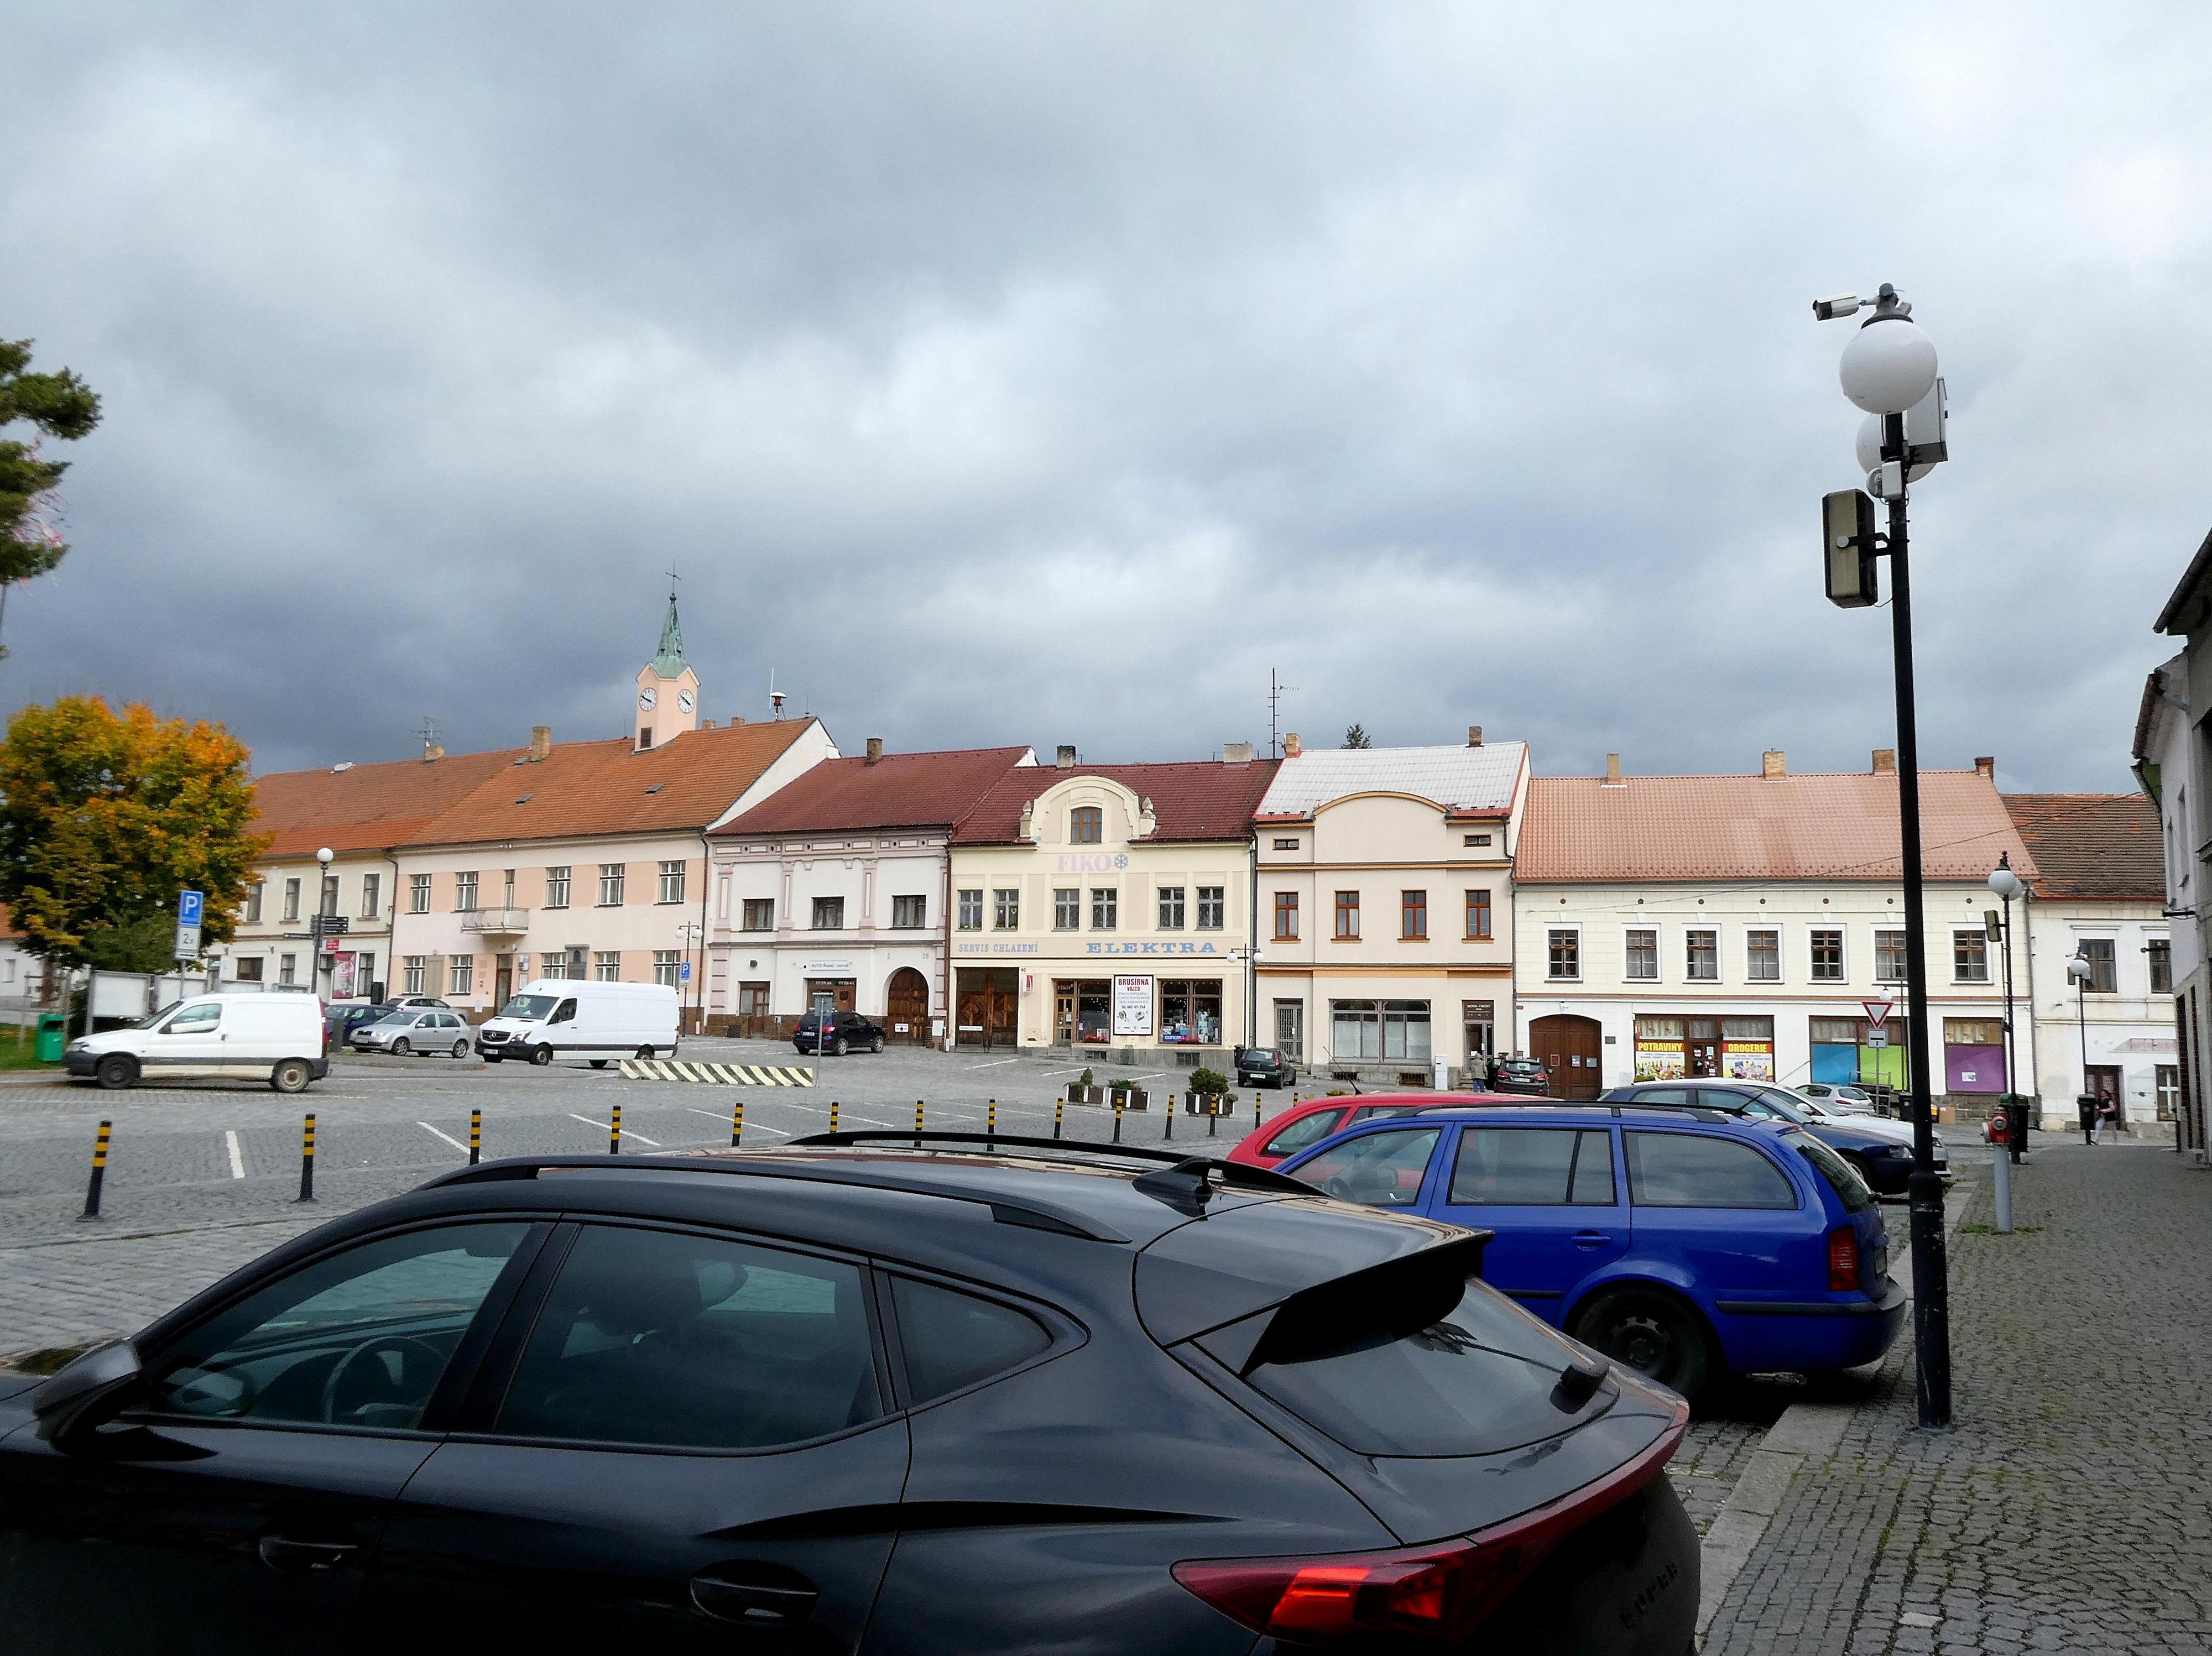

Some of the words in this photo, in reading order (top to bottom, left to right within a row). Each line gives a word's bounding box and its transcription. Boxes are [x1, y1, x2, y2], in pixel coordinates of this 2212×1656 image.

[1058, 854, 1112, 872] FIKO
[185, 895, 198, 915] P
[958, 944, 989, 952] SERVIS
[993, 941, 1039, 952] CHLAZENÍ
[1086, 942, 1217, 953] ELEKTRA
[682, 964, 688, 974] P
[1118, 977, 1149, 985] BRUSÍRNA
[1637, 1042, 1682, 1052] POTRAVINY
[1728, 1043, 1767, 1053] DROGERIE
